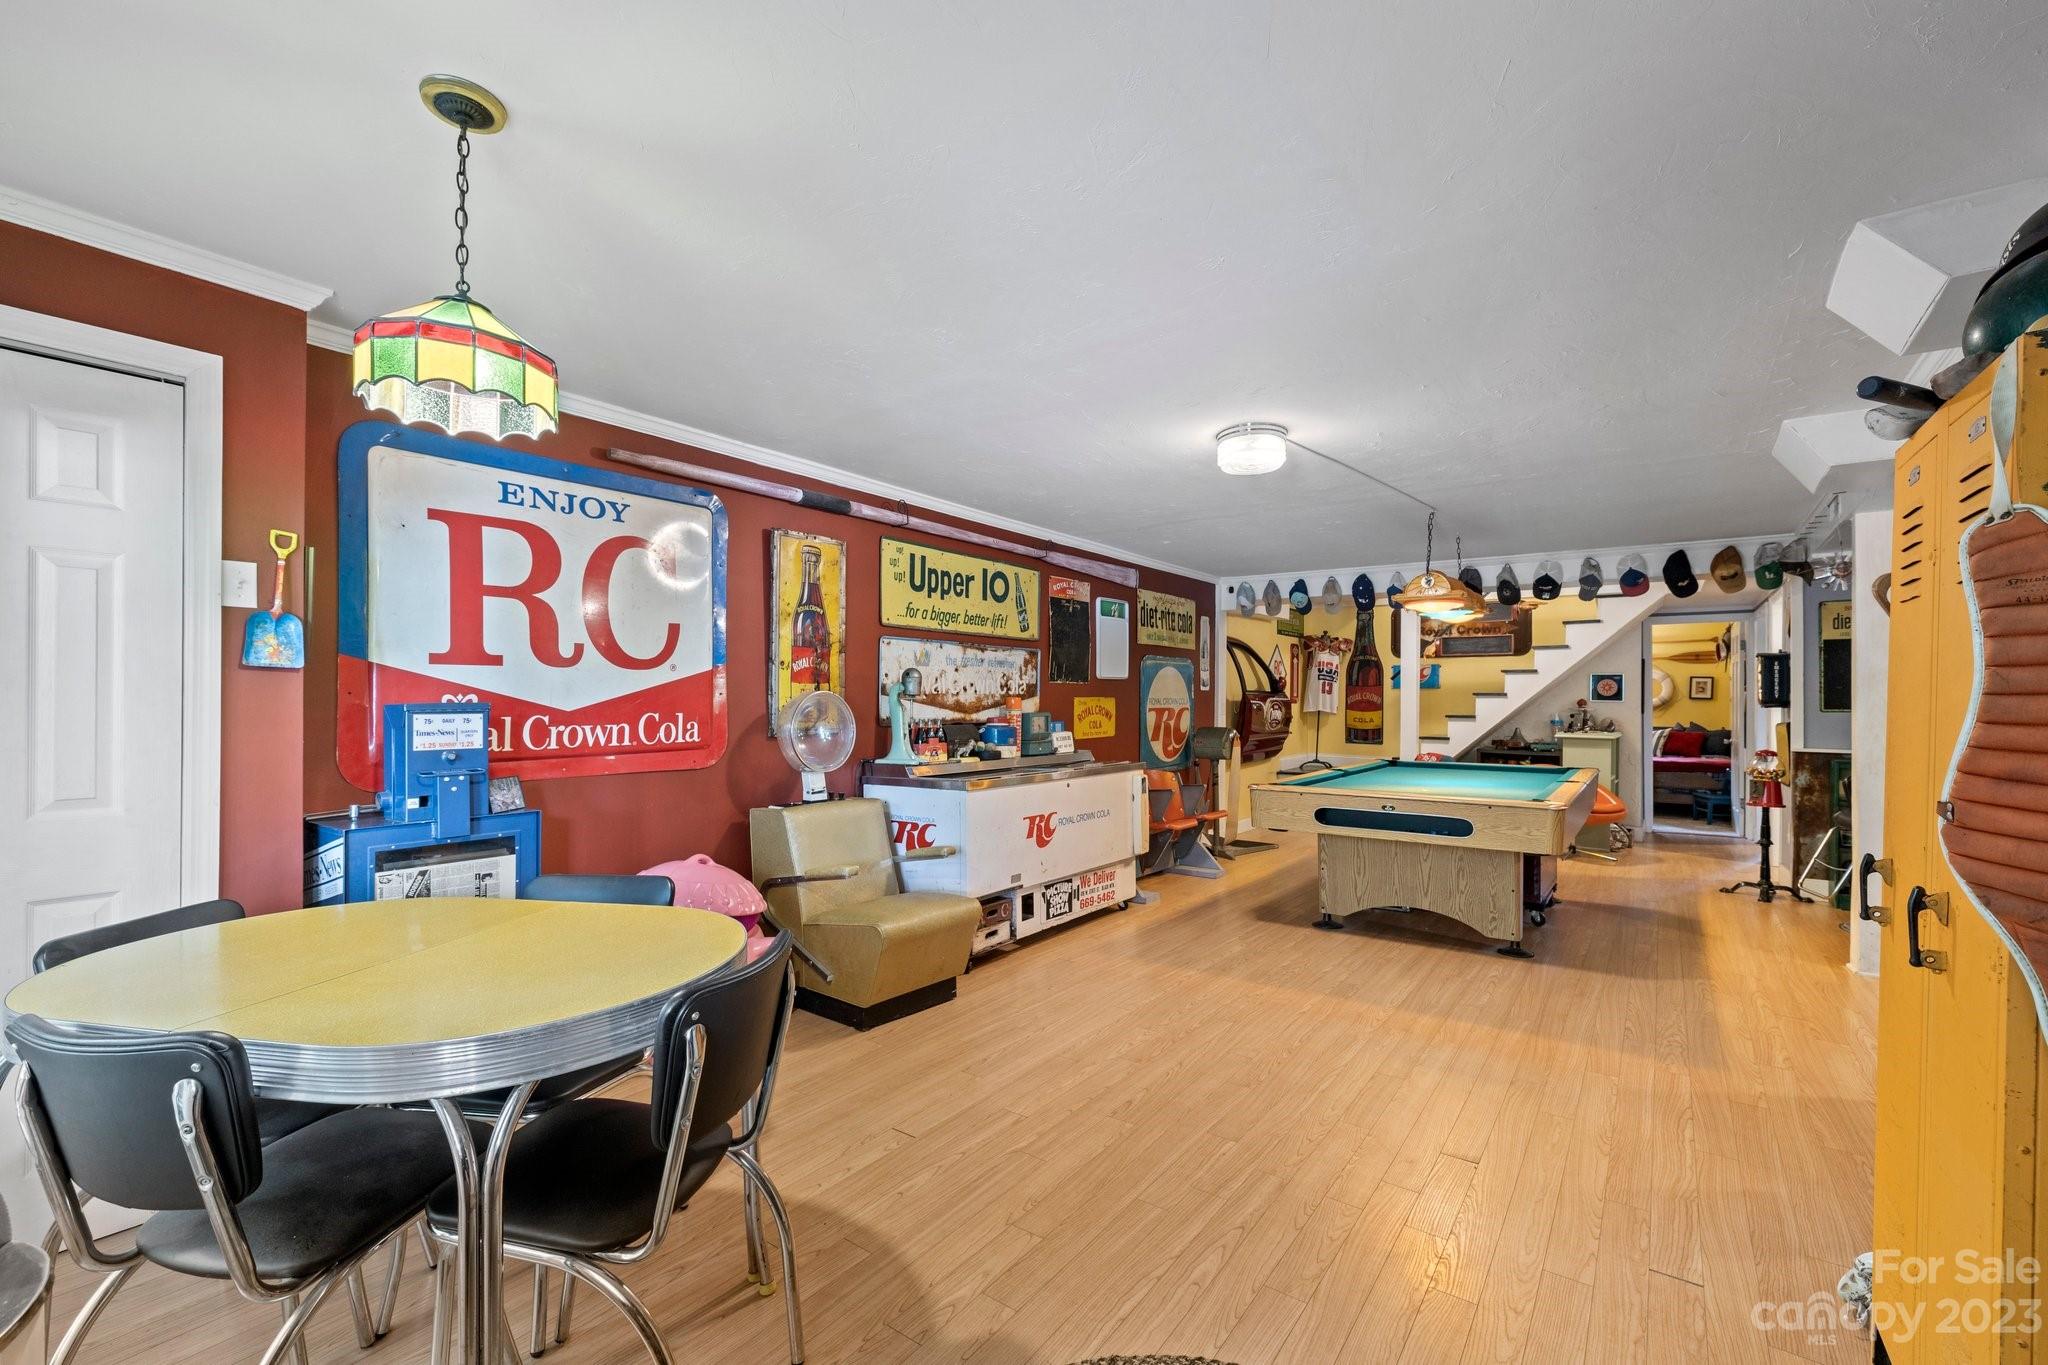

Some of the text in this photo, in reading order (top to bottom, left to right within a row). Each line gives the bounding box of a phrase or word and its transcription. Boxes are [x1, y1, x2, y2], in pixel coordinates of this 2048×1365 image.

[497, 480, 631, 524] ENJOY
[889, 557, 900, 568] up!
[894, 571, 906, 584] up!
[909, 552, 1010, 604] Upper 10
[427, 507, 681, 670] RC
[921, 608, 928, 617] a
[963, 610, 990, 628] better
[991, 614, 1008, 632] lift!
[1140, 599, 1176, 632] diet-rite
[1177, 611, 1193, 634] cola
[1457, 624, 1502, 635] Crown
[946, 654, 958, 666] the
[997, 670, 1027, 695] Cola
[1077, 704, 1113, 723] ROYAL CROWN
[415, 729, 456, 737] Times-News
[522, 714, 636, 751] Crown
[637, 711, 702, 746] Cola
[1088, 719, 1102, 729] COLA
[1147, 707, 1190, 760] RC
[891, 820, 937, 851] RC
[1023, 808, 1111, 849] RC ROYAL CROWN COLA
[1080, 870, 1117, 889] We Deliver
[1046, 881, 1073, 900] PICTURE
[1050, 892, 1070, 906] SHOW
[1080, 890, 1116, 910] 669-5462
[1049, 902, 1070, 918] PIZZA
